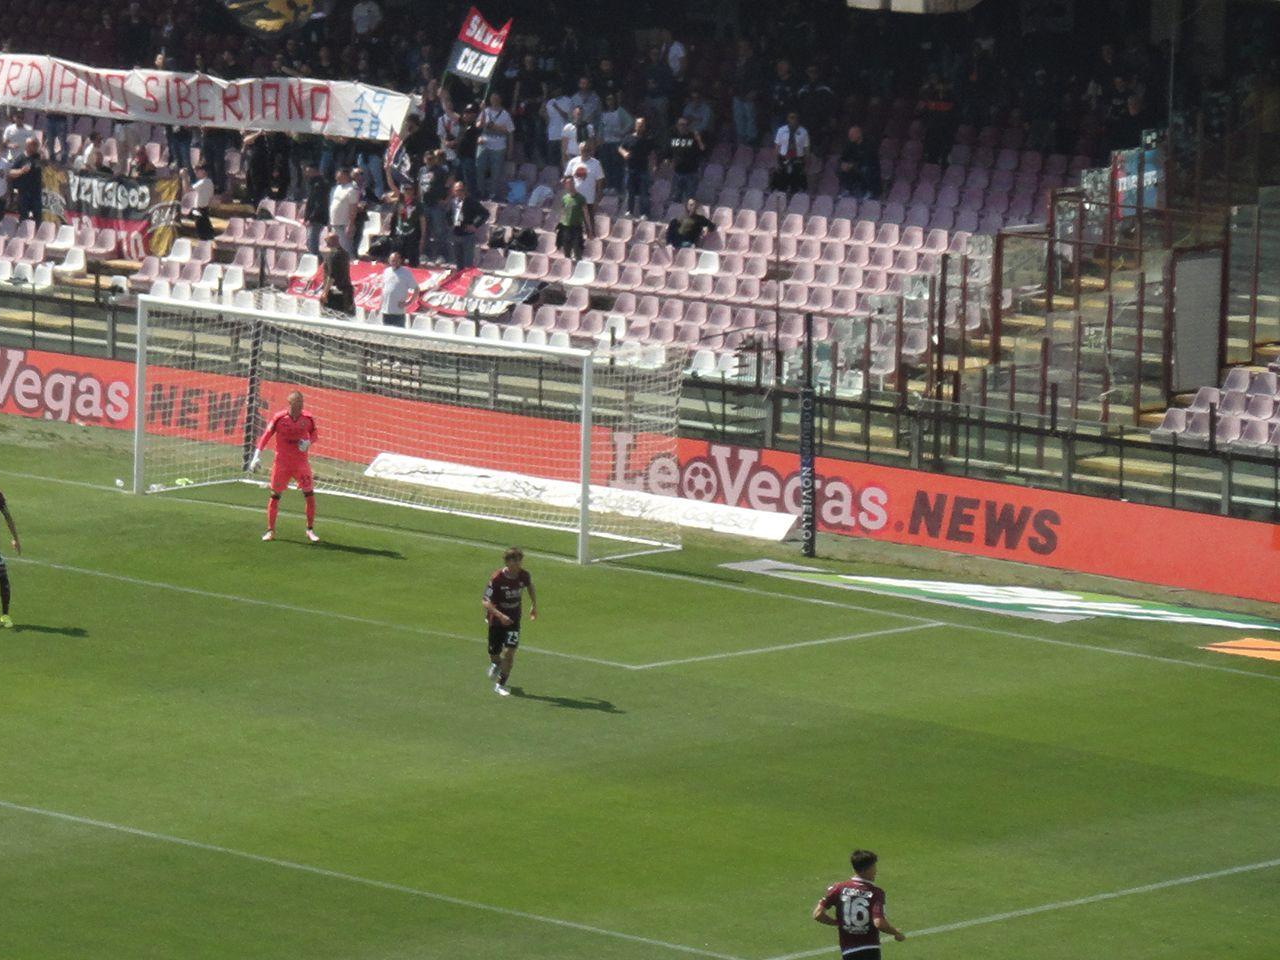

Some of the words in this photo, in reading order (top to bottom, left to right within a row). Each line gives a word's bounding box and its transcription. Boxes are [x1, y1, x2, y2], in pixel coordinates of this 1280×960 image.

[143, 75, 332, 124] SIBERIANO
[801, 466, 813, 540] NOVIELLO
[840, 895, 870, 928] 16
